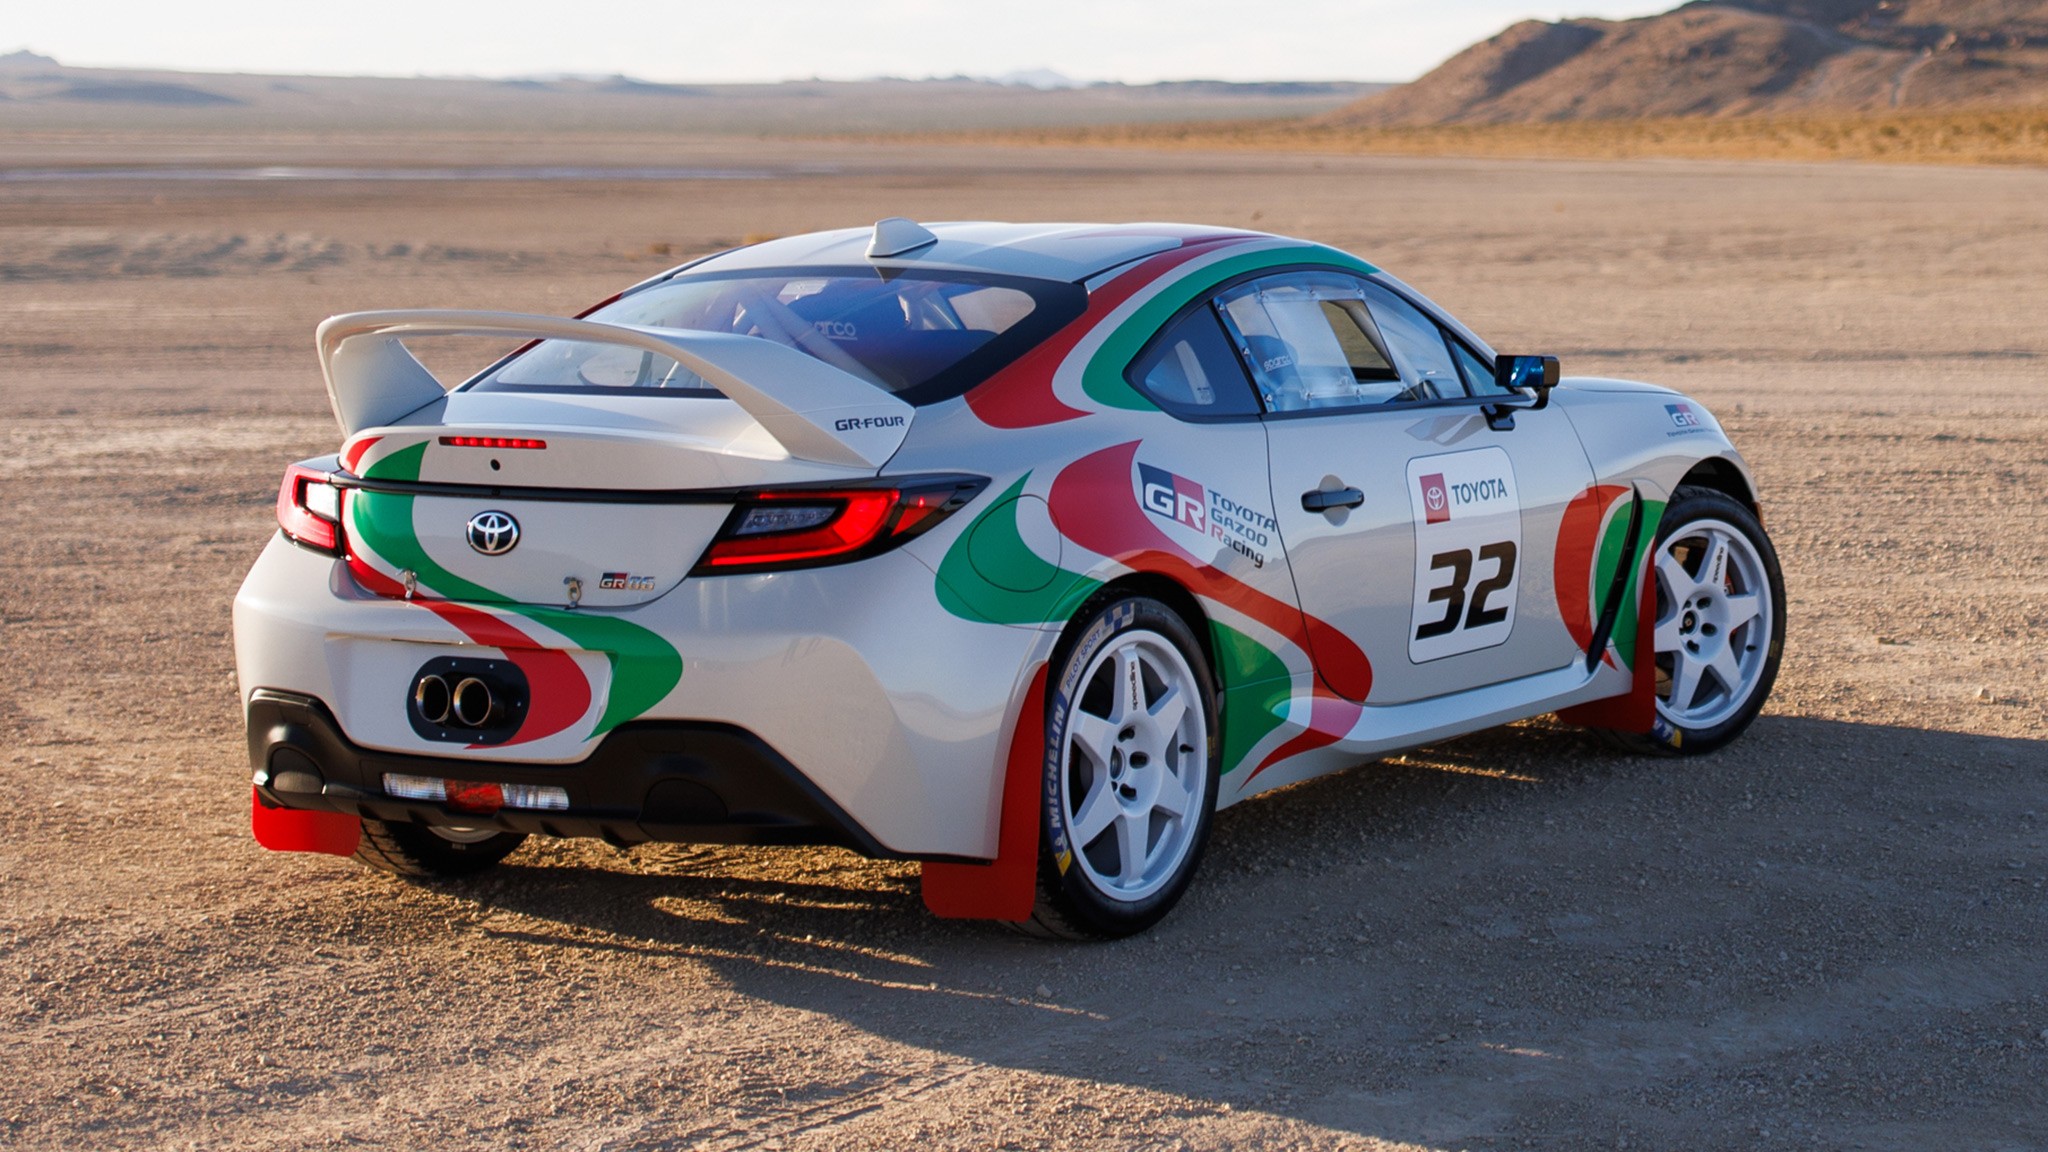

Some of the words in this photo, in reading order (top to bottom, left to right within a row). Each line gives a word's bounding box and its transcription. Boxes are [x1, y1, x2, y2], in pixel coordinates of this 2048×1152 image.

[1671, 411, 1700, 427] GR
[1144, 481, 1206, 533] GR
[1208, 489, 1277, 533] TOYOTA
[1451, 478, 1508, 506] TOYOTA
[1211, 507, 1268, 548] GAZOO
[1211, 524, 1265, 570] Racing
[1415, 540, 1518, 641] 32
[1066, 657, 1081, 690] PILOT
[1080, 629, 1101, 659] SPORT
[1047, 703, 1066, 829] MICHELIN
